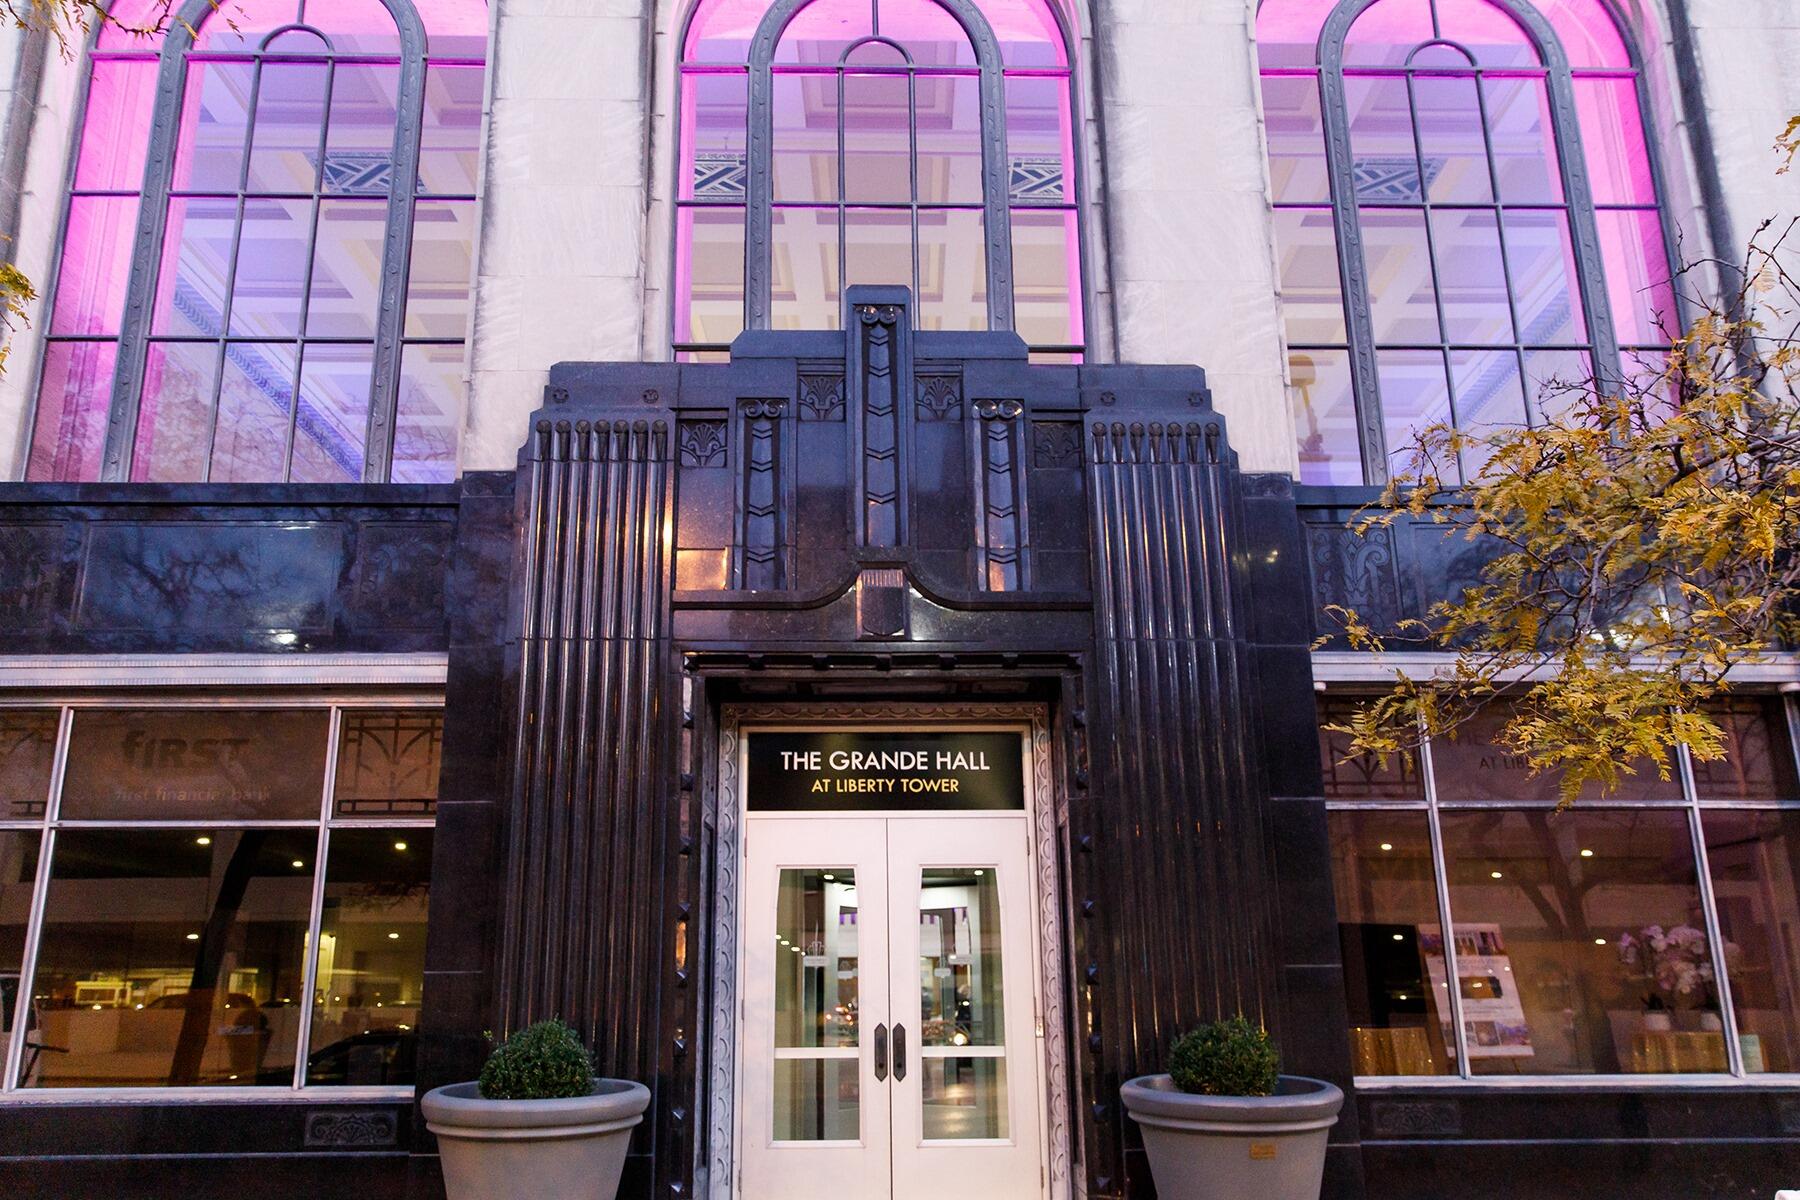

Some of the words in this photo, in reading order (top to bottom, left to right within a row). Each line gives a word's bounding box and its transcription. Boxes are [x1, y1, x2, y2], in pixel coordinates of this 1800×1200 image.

[781, 751, 821, 770] THE
[829, 751, 928, 770] GRANDE
[937, 751, 990, 770] HALL
[812, 779, 831, 792] AT
[837, 779, 895, 792] LIBERTY
[901, 779, 959, 792] TOWER
